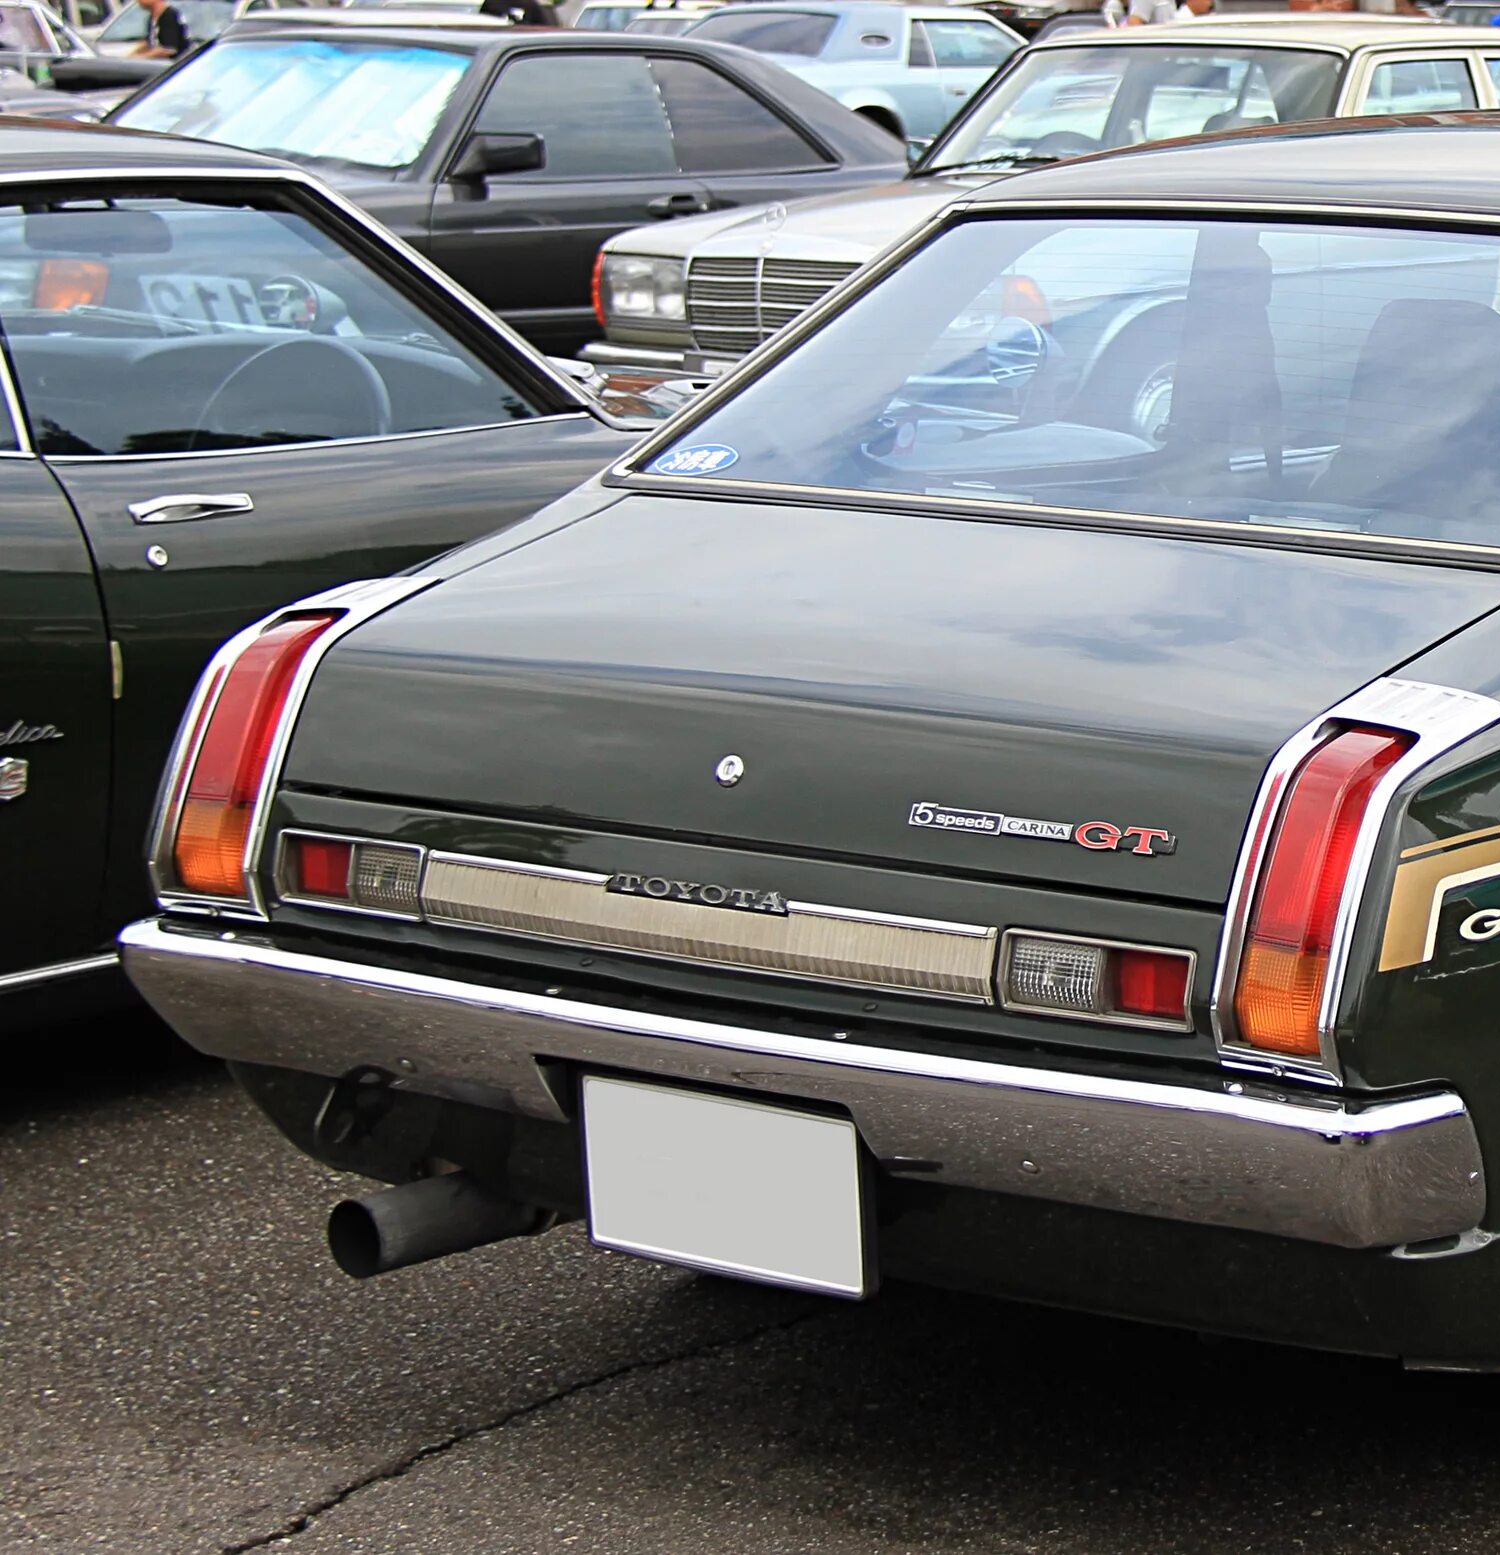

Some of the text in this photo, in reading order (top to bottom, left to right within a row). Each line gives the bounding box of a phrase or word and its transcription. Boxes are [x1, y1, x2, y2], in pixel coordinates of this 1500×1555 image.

[914, 802, 1168, 855] 5 speeds CARINA GT
[615, 873, 786, 913] TOYOTA
